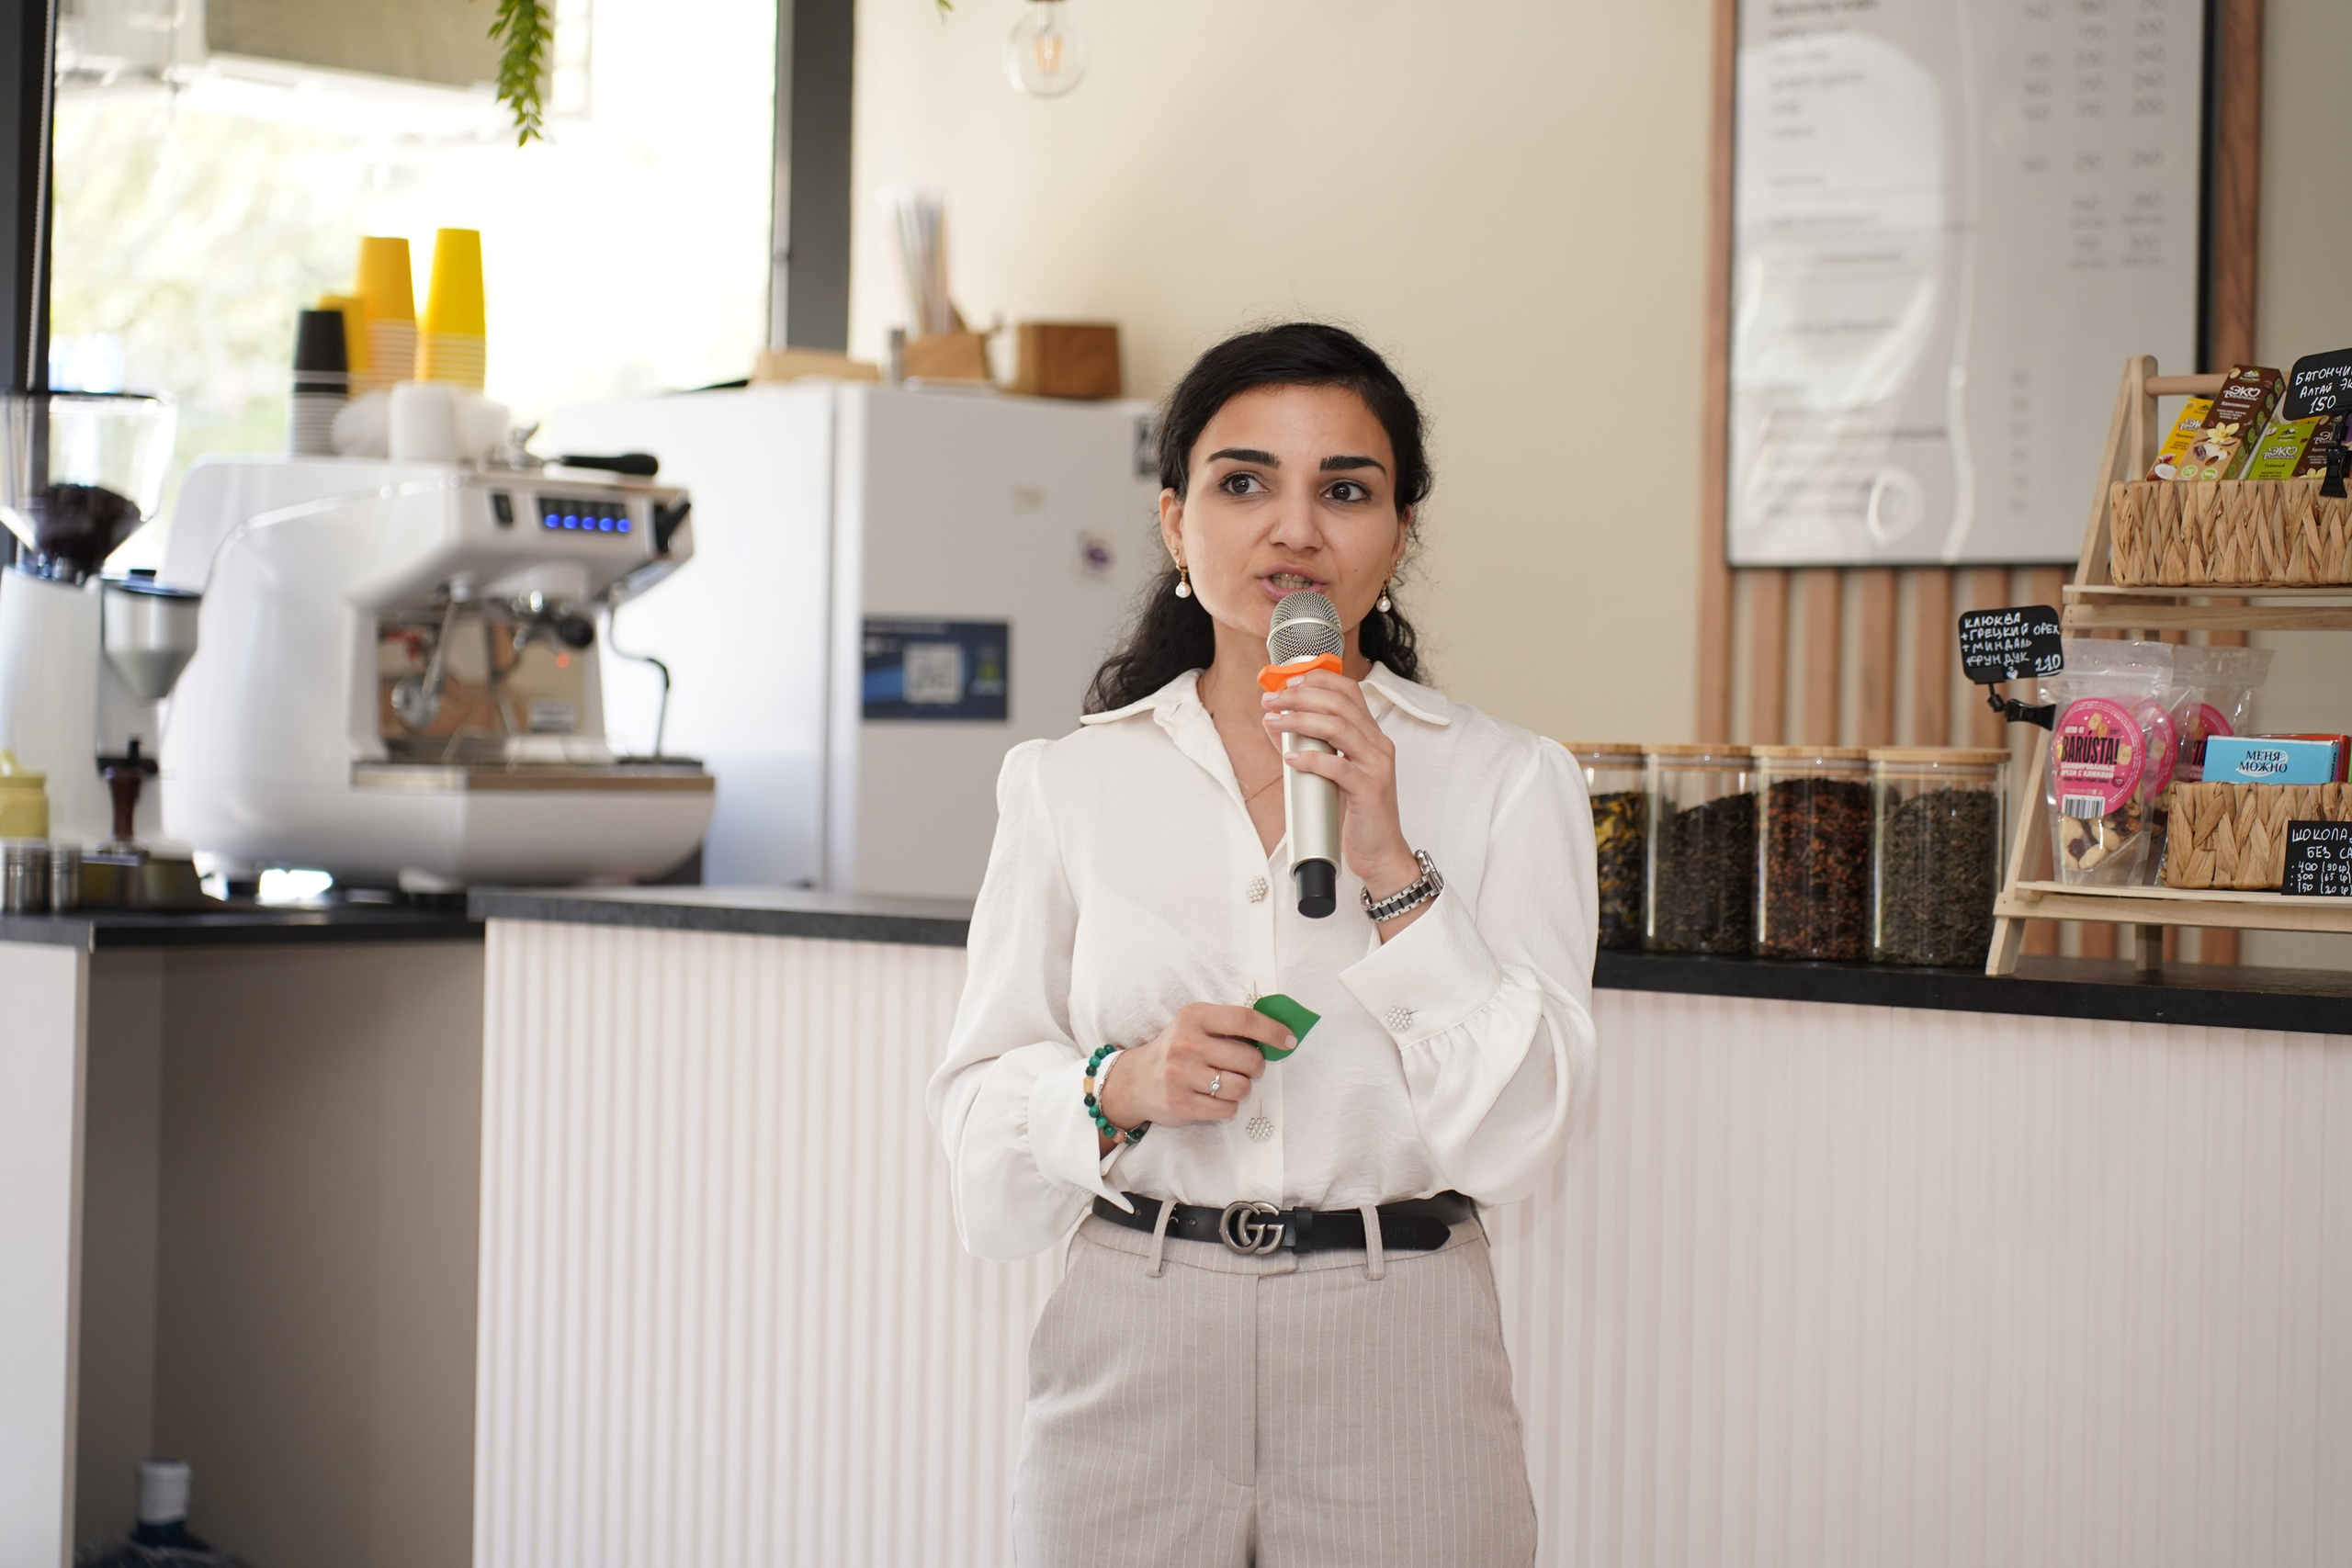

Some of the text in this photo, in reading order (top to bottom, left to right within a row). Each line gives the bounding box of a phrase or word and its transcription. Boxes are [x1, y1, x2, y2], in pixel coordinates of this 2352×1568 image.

[2295, 366, 2352, 386] БАТОНЧИ
[2309, 395, 2336, 414] 150
[1964, 612, 2020, 629] КЛЮКВА
[2033, 622, 2060, 636] ОРЕХ
[2035, 654, 2062, 671] 210
[2245, 750, 2280, 761] МЕНЯ
[2239, 761, 2288, 773] МОЖНО
[2307, 845, 2331, 859] БЕЗ
[2298, 861, 2318, 874] 400
[2297, 873, 2313, 882] 300
[2298, 881, 2313, 893] 150
